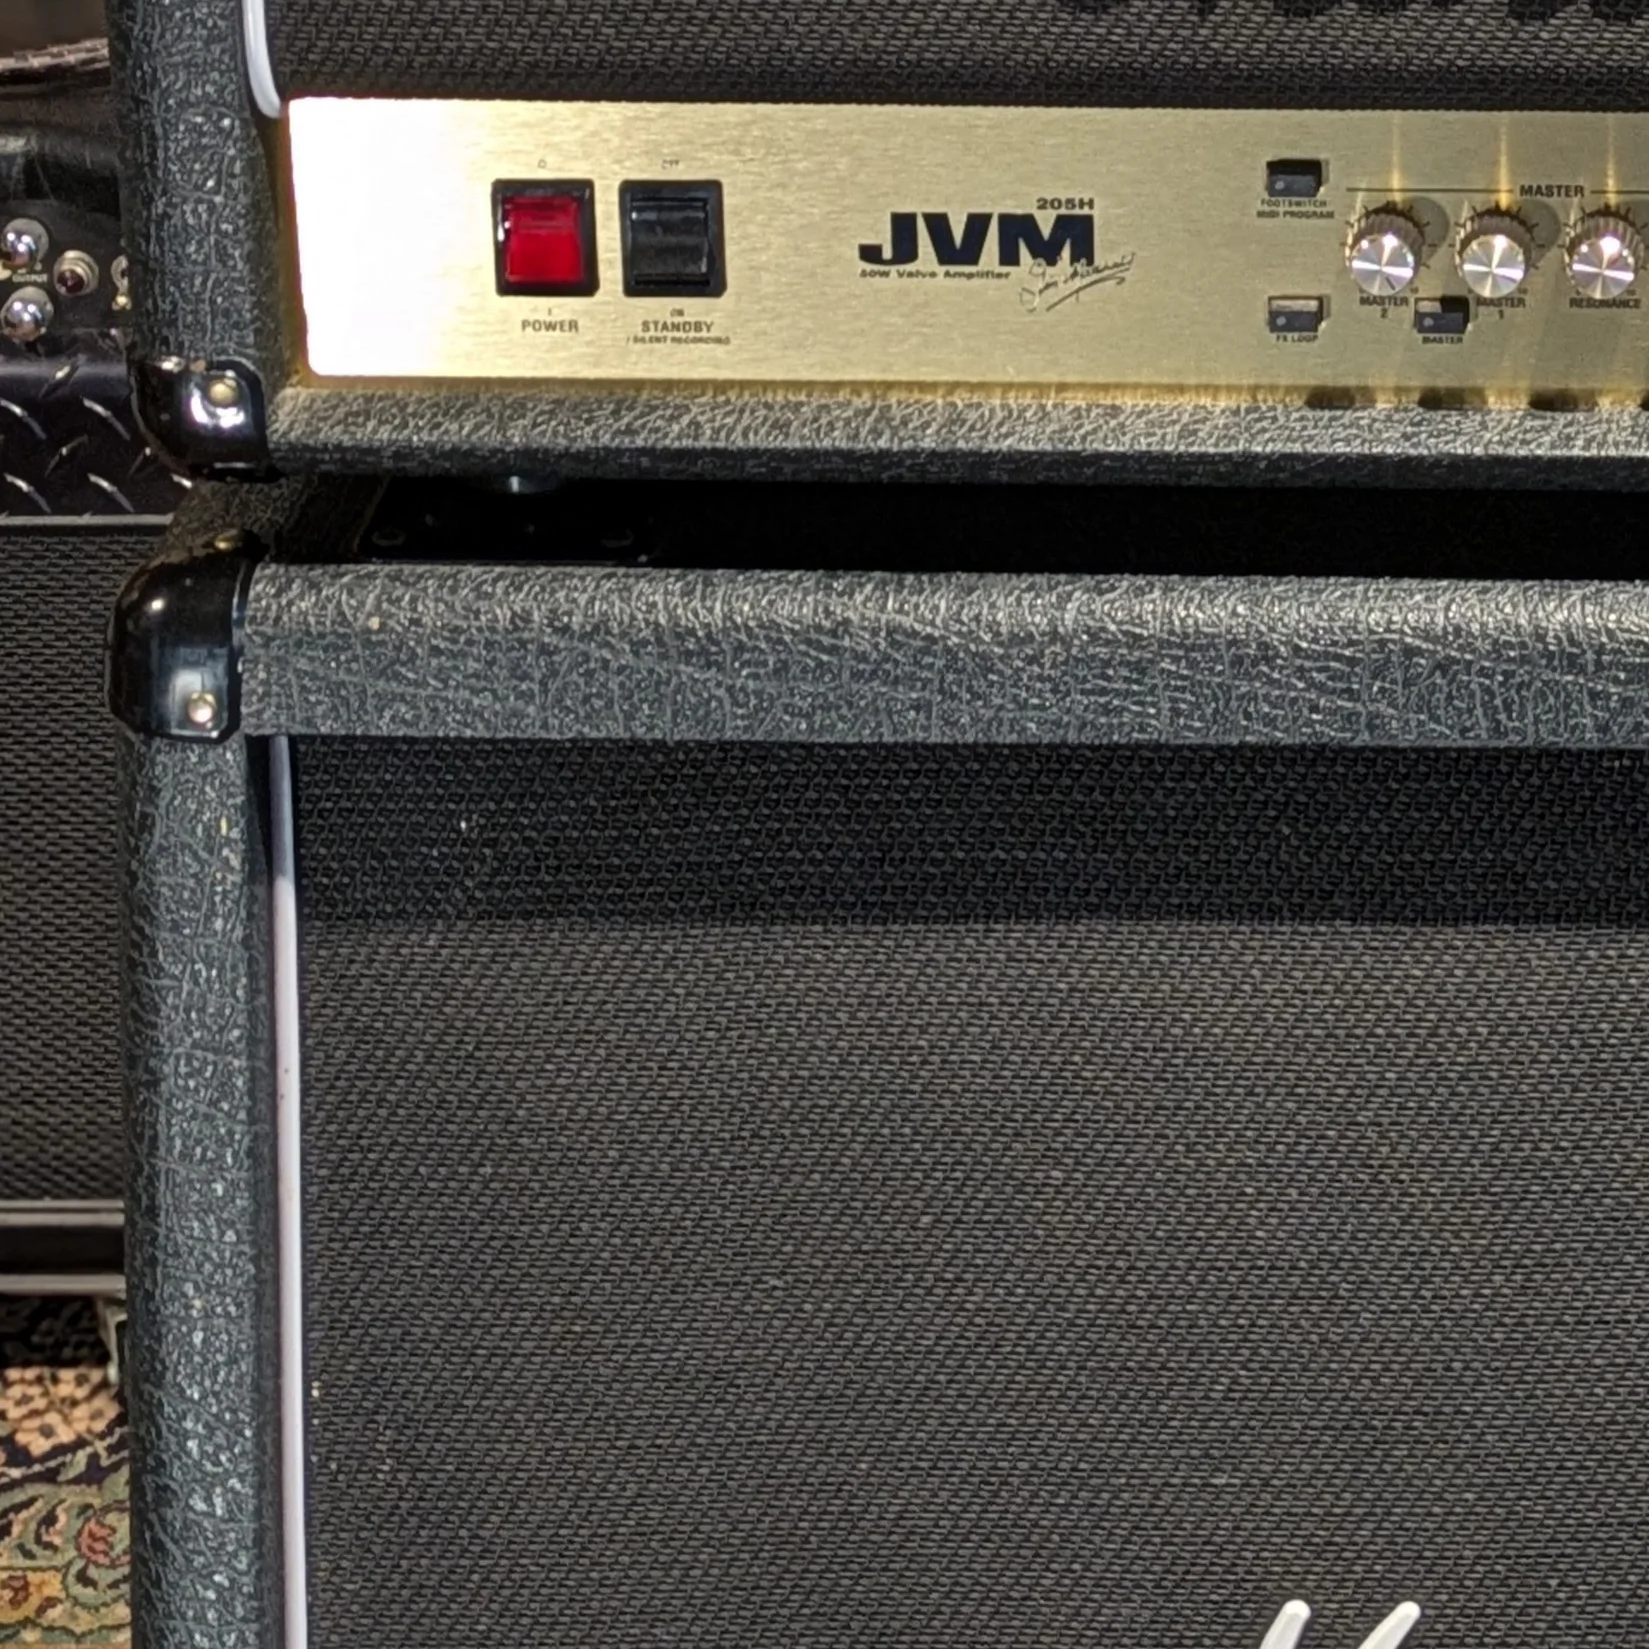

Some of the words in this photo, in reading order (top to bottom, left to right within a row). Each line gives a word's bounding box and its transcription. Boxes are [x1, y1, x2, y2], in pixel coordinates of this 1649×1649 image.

[1519, 184, 1585, 198] MASTER
[1036, 197, 1095, 210] 205H
[858, 212, 1095, 267] JVM
[896, 269, 937, 279] Valve
[943, 270, 1012, 281] Amplifier
[1359, 296, 1409, 307] MASTER
[1476, 297, 1527, 308] MASTER
[1569, 297, 1641, 309] RESONANCE
[521, 318, 579, 333] POWER
[641, 320, 714, 334] STANDBY
